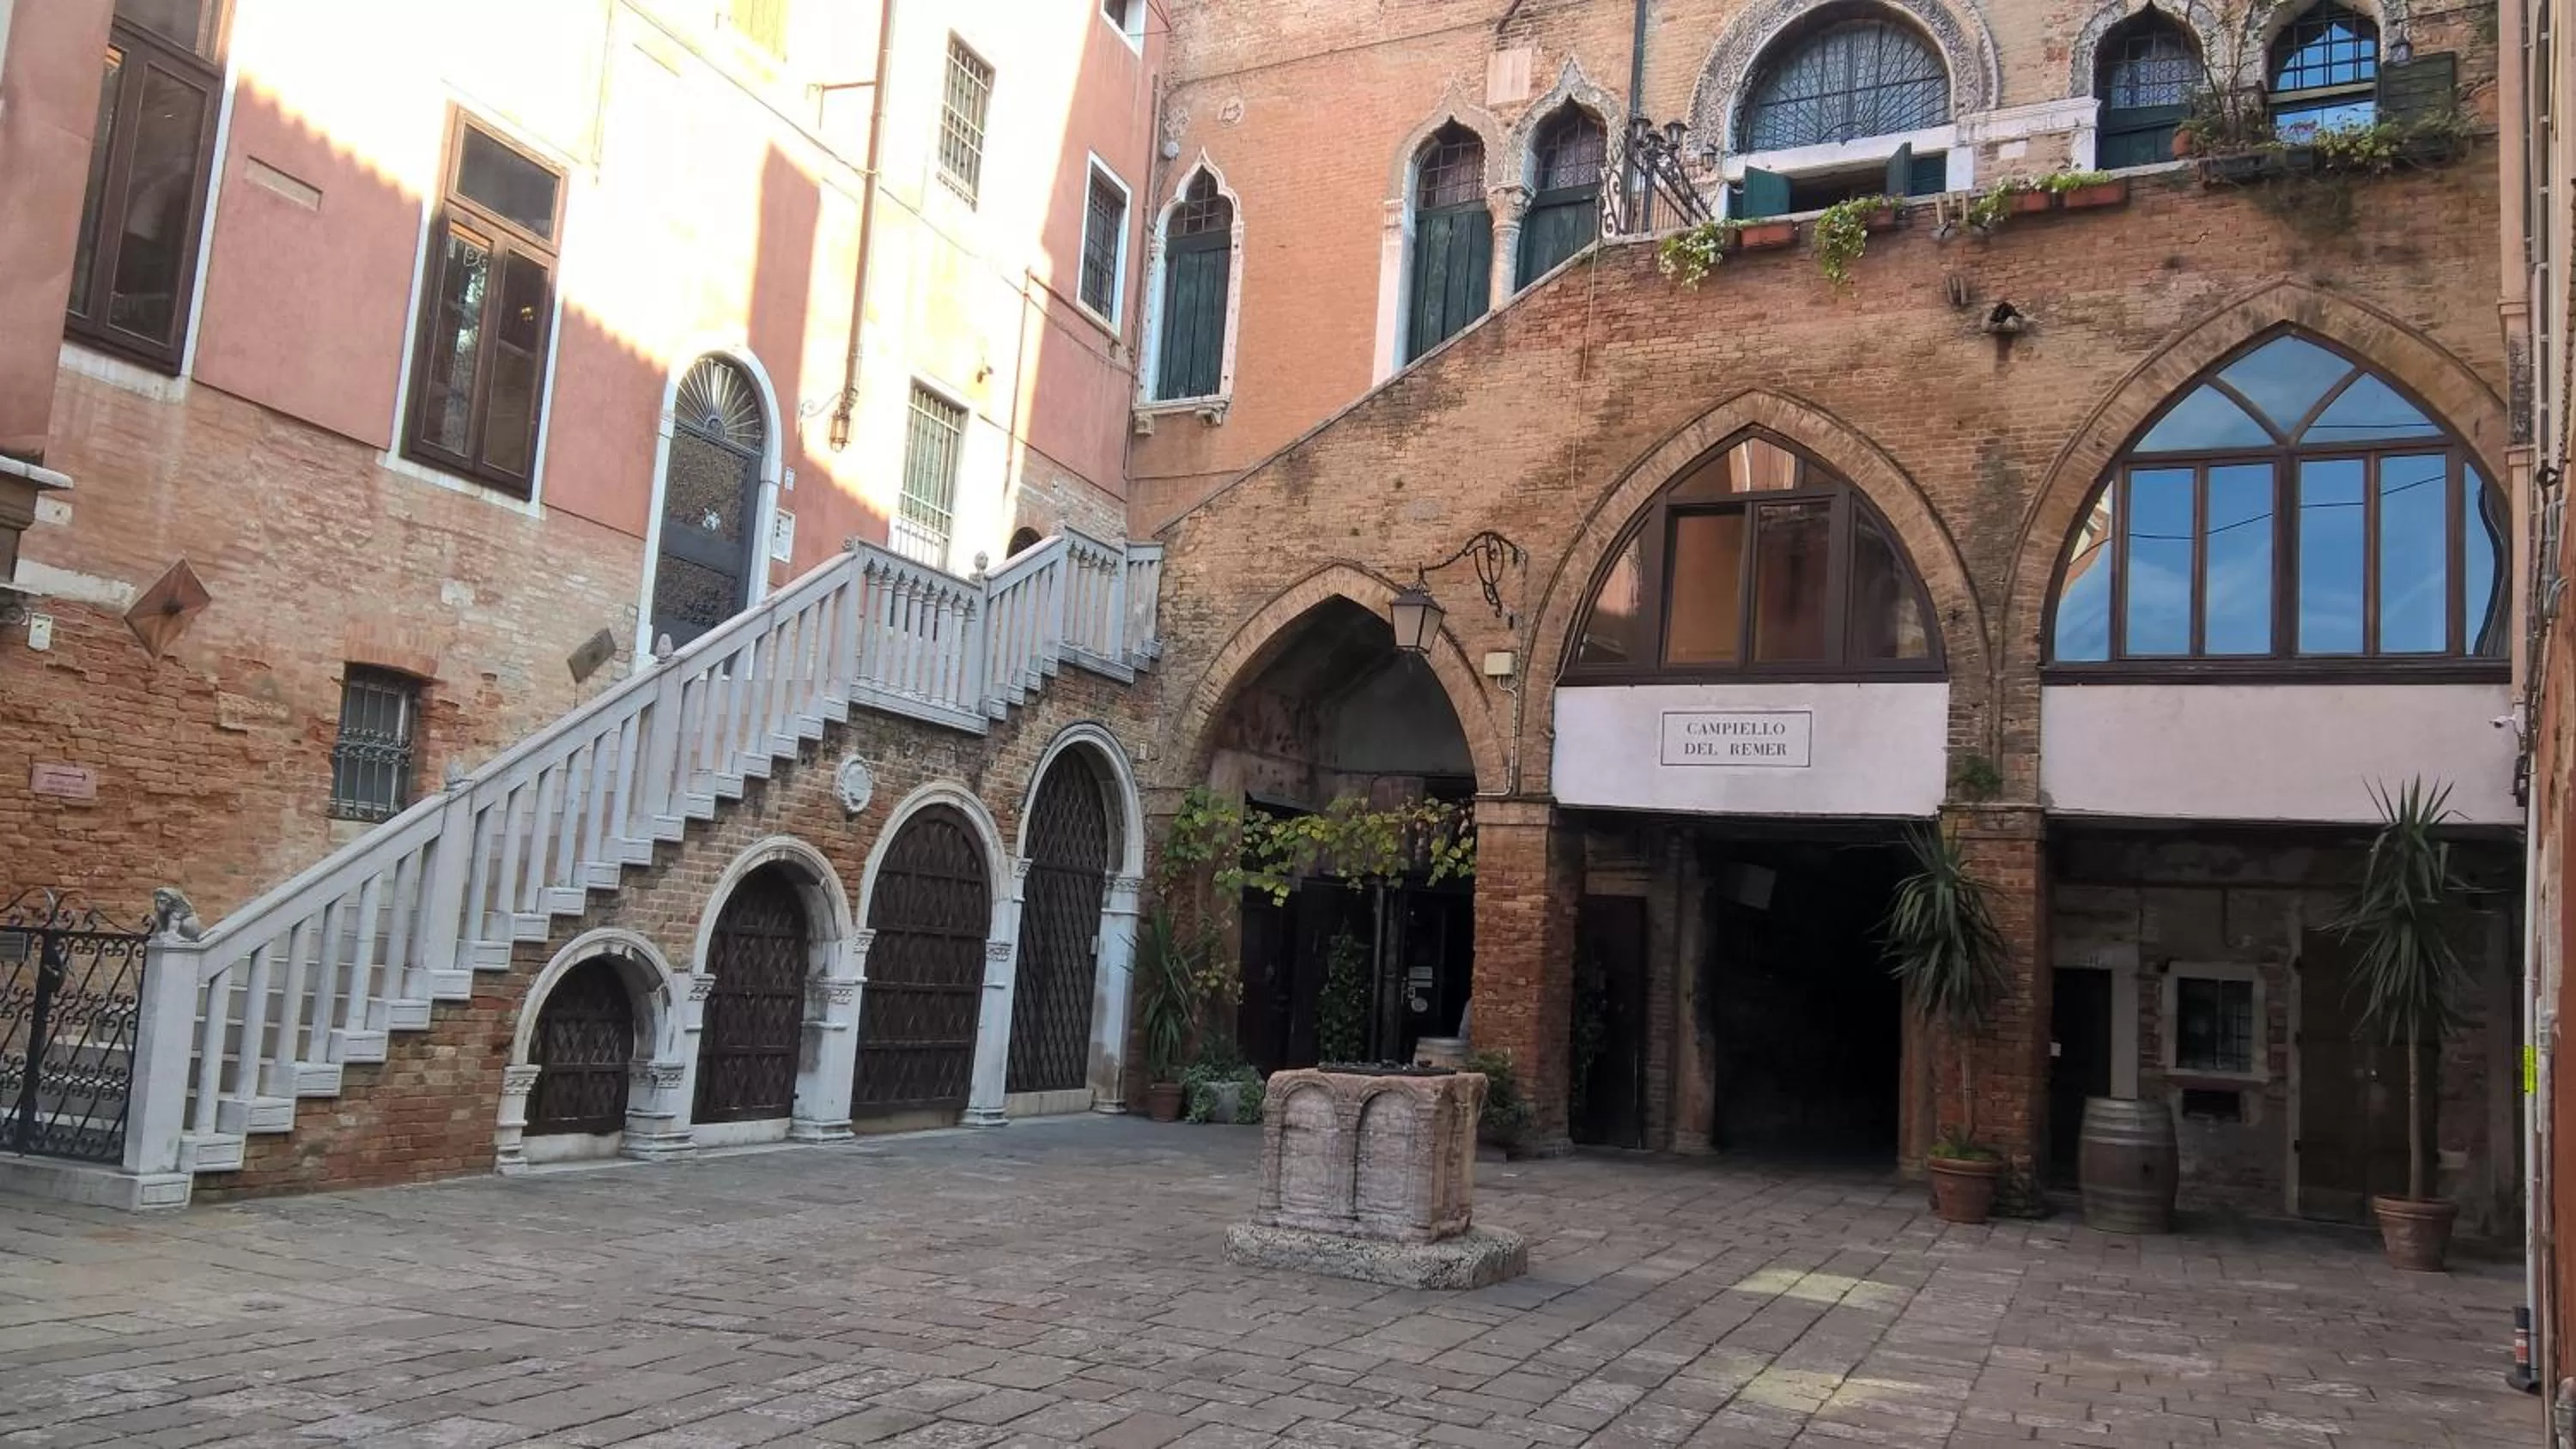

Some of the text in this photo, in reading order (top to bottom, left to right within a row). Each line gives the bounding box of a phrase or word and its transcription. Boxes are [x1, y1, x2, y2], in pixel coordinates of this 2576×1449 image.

[1686, 721, 1786, 735] CAMPIELLO
[1684, 743, 1786, 756] DEL REMER
